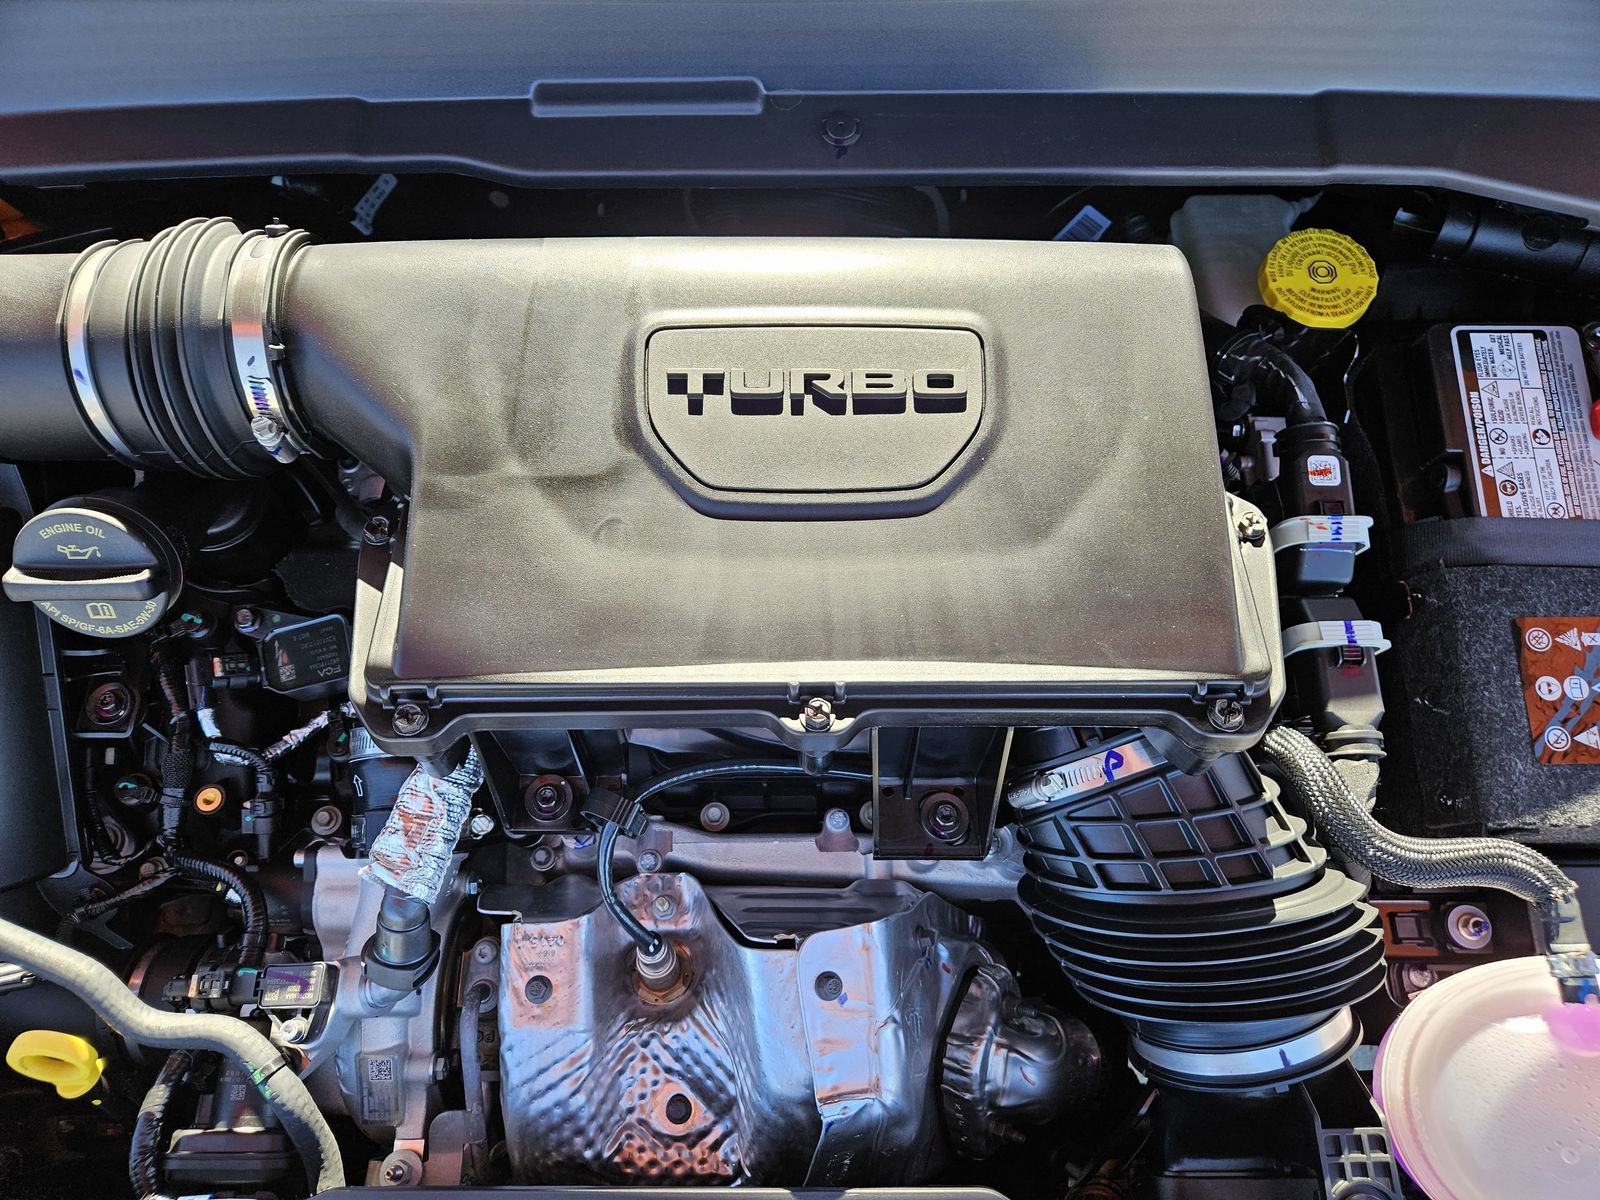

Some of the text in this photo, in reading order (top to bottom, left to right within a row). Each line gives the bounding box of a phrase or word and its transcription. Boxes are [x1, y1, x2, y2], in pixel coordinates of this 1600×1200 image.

[1270, 245, 1282, 261] GARDE
[1294, 249, 1324, 270] CONTENANT
[1276, 287, 1287, 297] DOT
[1290, 299, 1306, 311] FLUID
[1306, 308, 1324, 316] FROM
[1331, 308, 1353, 317] SEALED
[1286, 287, 1307, 304] BEFORE
[1343, 298, 1354, 307] USE
[1353, 286, 1364, 298] ONLY
[1300, 290, 1320, 301] CLEAN
[1496, 335, 1505, 355] MEDICAL
[1481, 346, 1491, 377] IMMEDIATELY
[667, 368, 967, 415] TURBO
[1547, 372, 1557, 393] CHARGING
[1487, 397, 1497, 421] SULFURIC
[1510, 399, 1518, 421] BLINDNESS
[1552, 394, 1560, 410] PROPER
[1470, 391, 1491, 464] DANGER/POISON
[1555, 411, 1564, 429] FOLLOW
[1561, 440, 1570, 461] INVERTED
[1524, 471, 1533, 494] BLINDNESS
[1567, 471, 1579, 505] RECOMMENDED
[1517, 473, 1531, 517] XPLOSIVE GASES
[1506, 501, 1515, 517] HIELD
[39, 523, 106, 539] ENGINE OIL
[41, 600, 60, 617] API
[317, 664, 342, 677] FCA
